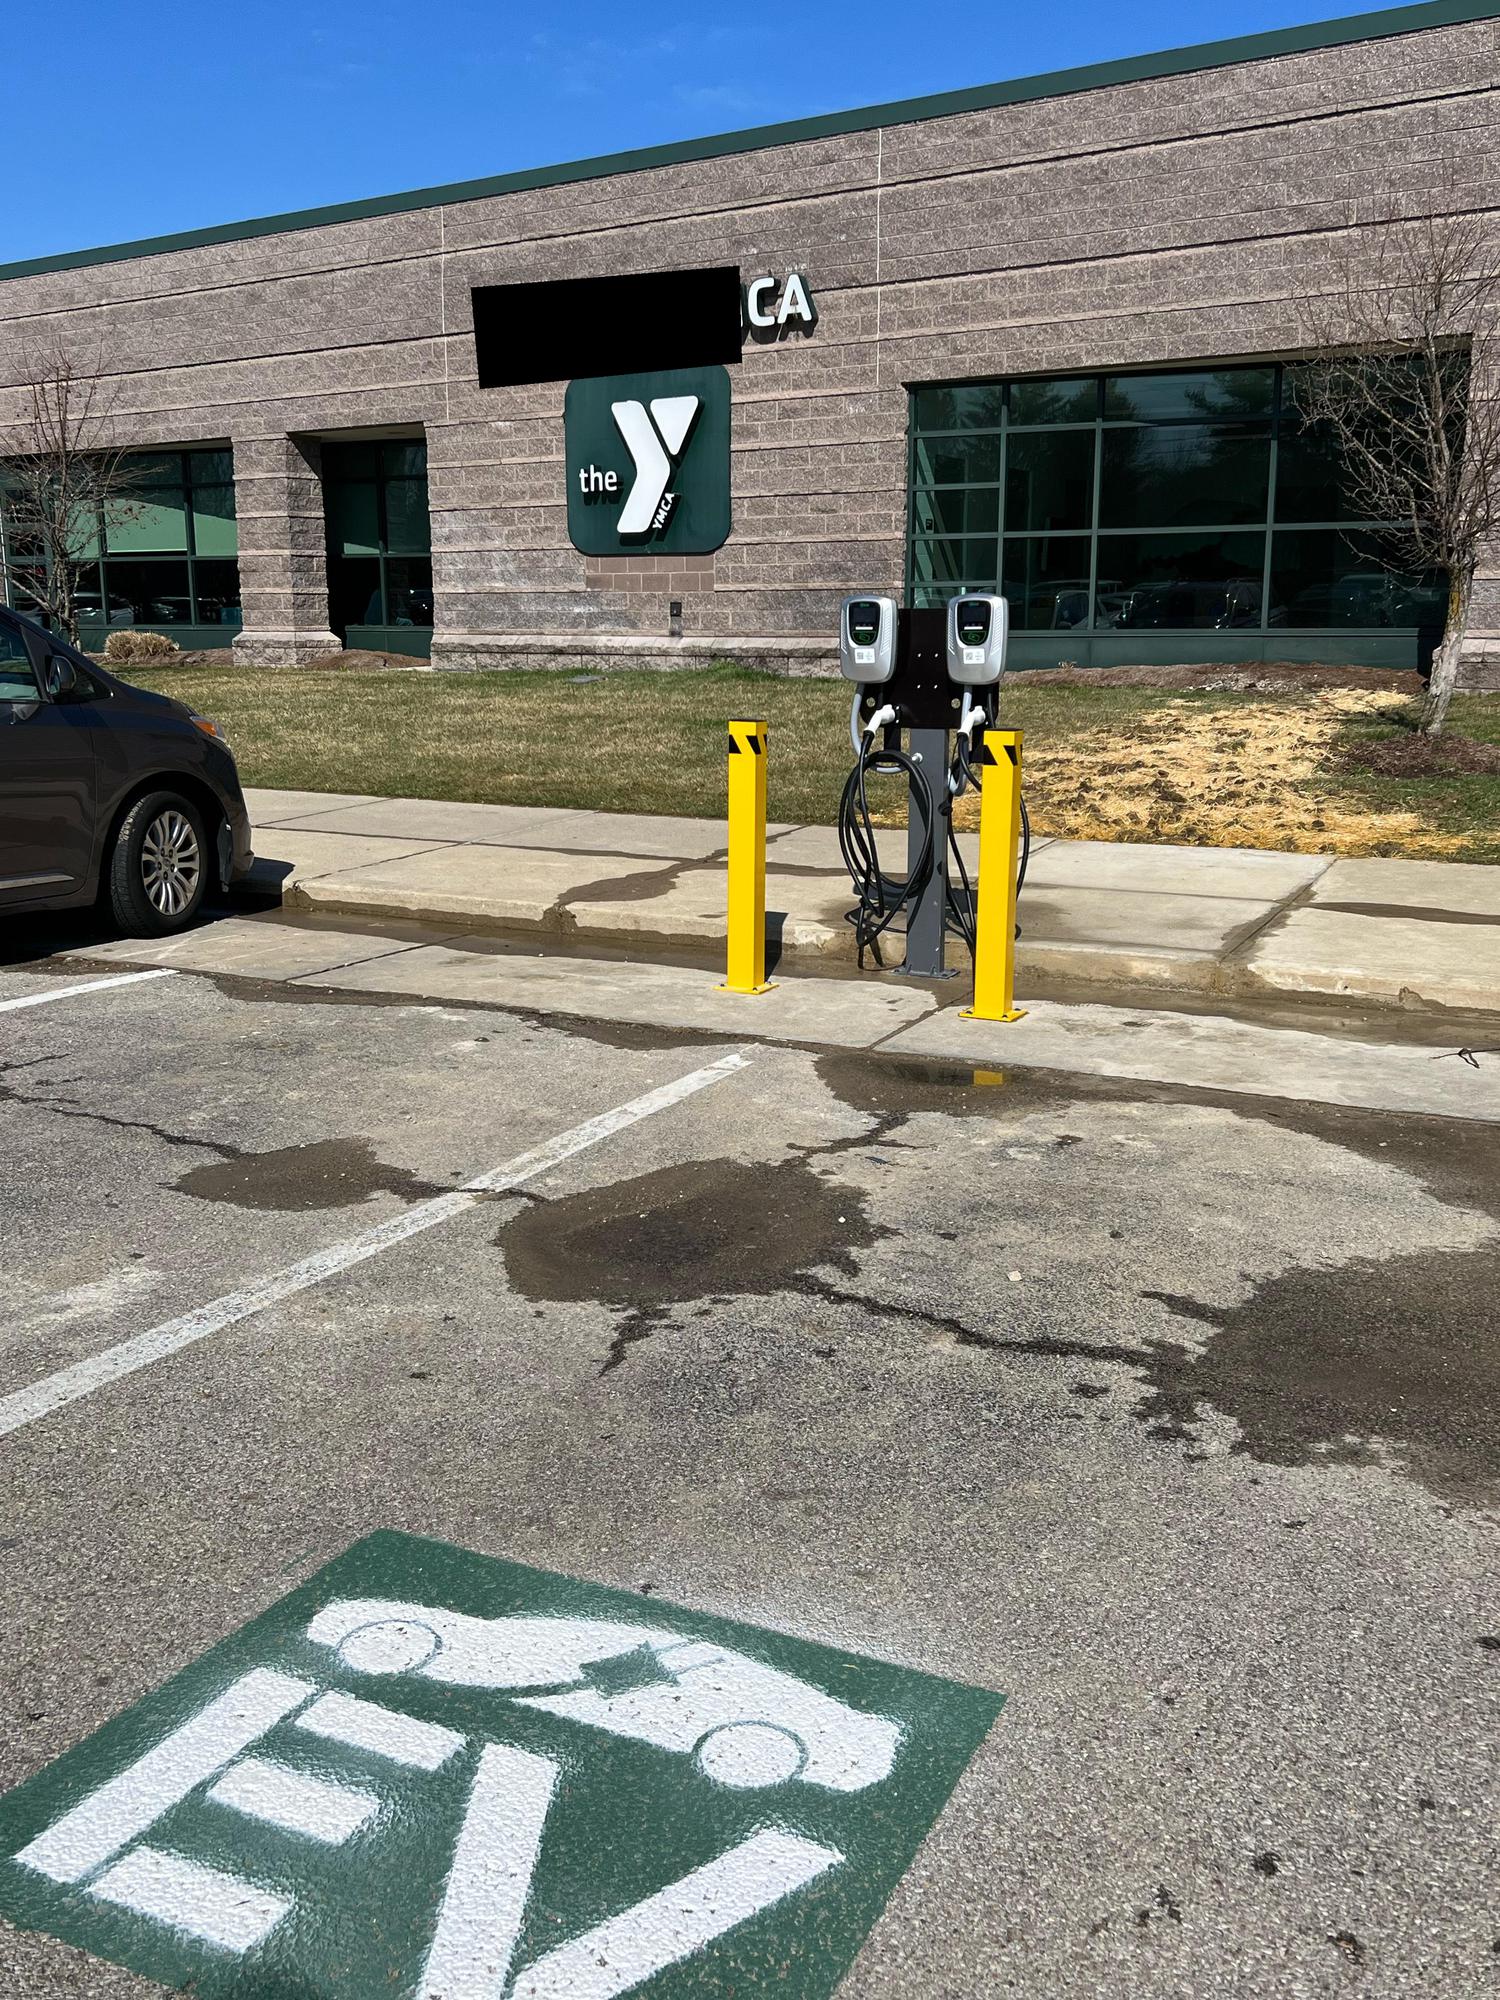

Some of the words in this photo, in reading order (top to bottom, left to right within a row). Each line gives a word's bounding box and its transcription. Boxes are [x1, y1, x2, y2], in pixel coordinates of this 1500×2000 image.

[740, 273, 812, 327] CA
[579, 464, 617, 492] the
[611, 395, 699, 533] Y
[652, 492, 675, 529] YMCA
[14, 1667, 846, 2000] EV
